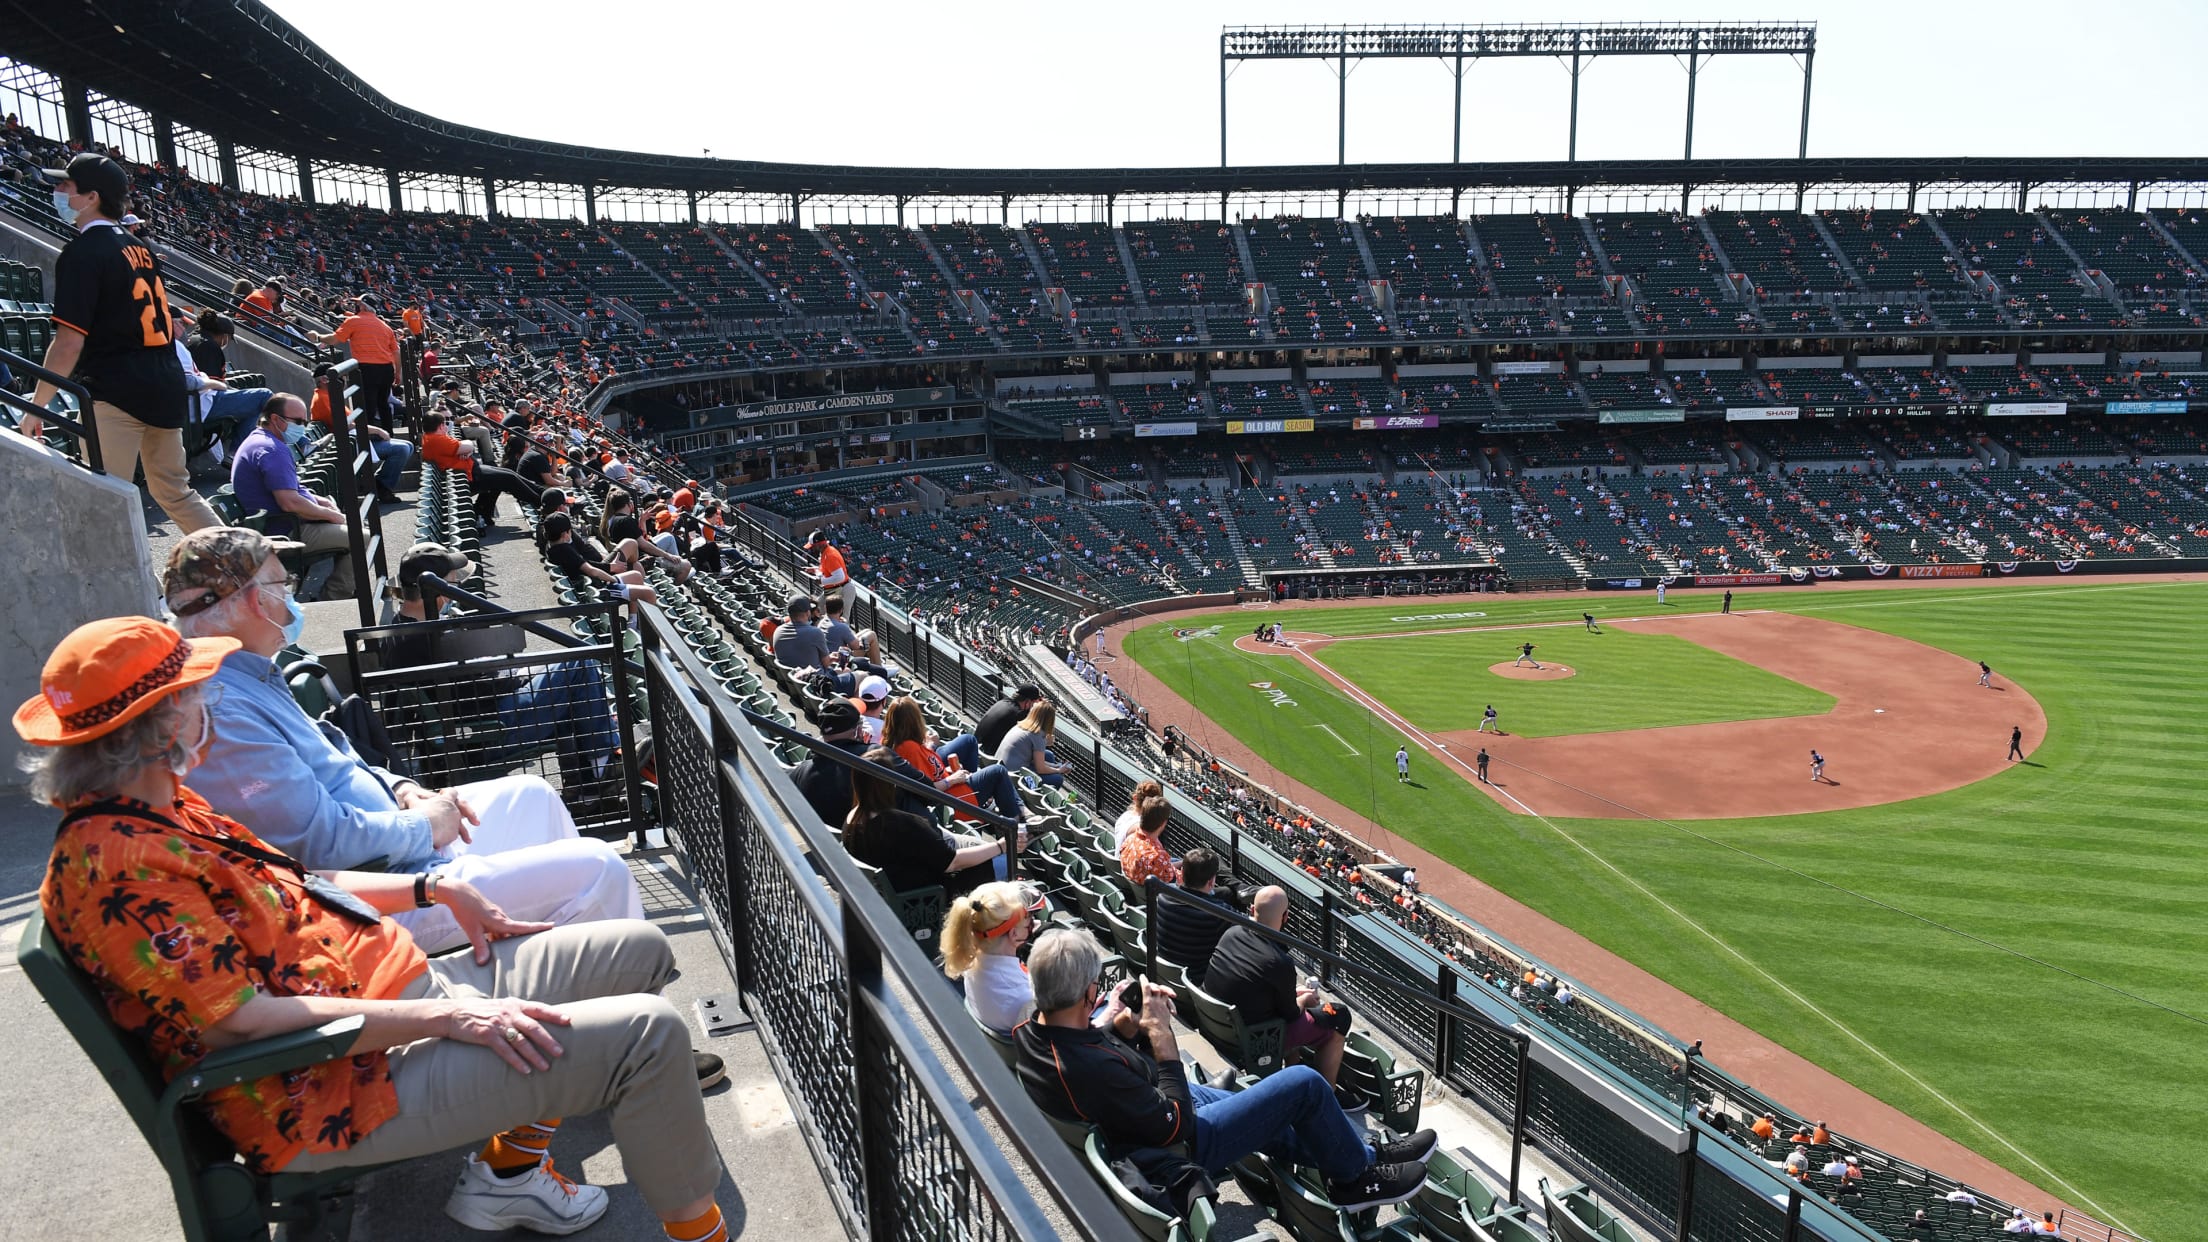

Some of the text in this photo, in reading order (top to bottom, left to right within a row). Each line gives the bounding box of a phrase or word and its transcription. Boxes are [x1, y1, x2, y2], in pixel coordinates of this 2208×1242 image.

[121, 245, 154, 272] HAYS
[132, 275, 173, 347] 21
[763, 402, 794, 416] ORIOLE
[795, 400, 818, 413] PARK
[825, 396, 865, 409] CAMDEN
[865, 393, 894, 406] YARDS
[1246, 422, 1264, 432] OLD
[1264, 421, 1282, 432] BAY
[1287, 420, 1312, 431] SEASON
[1387, 417, 1424, 425] E-ZPass
[1153, 425, 1194, 434] Constellation
[1904, 566, 1944, 577] VIZZY
[1258, 689, 1299, 708] PNC
